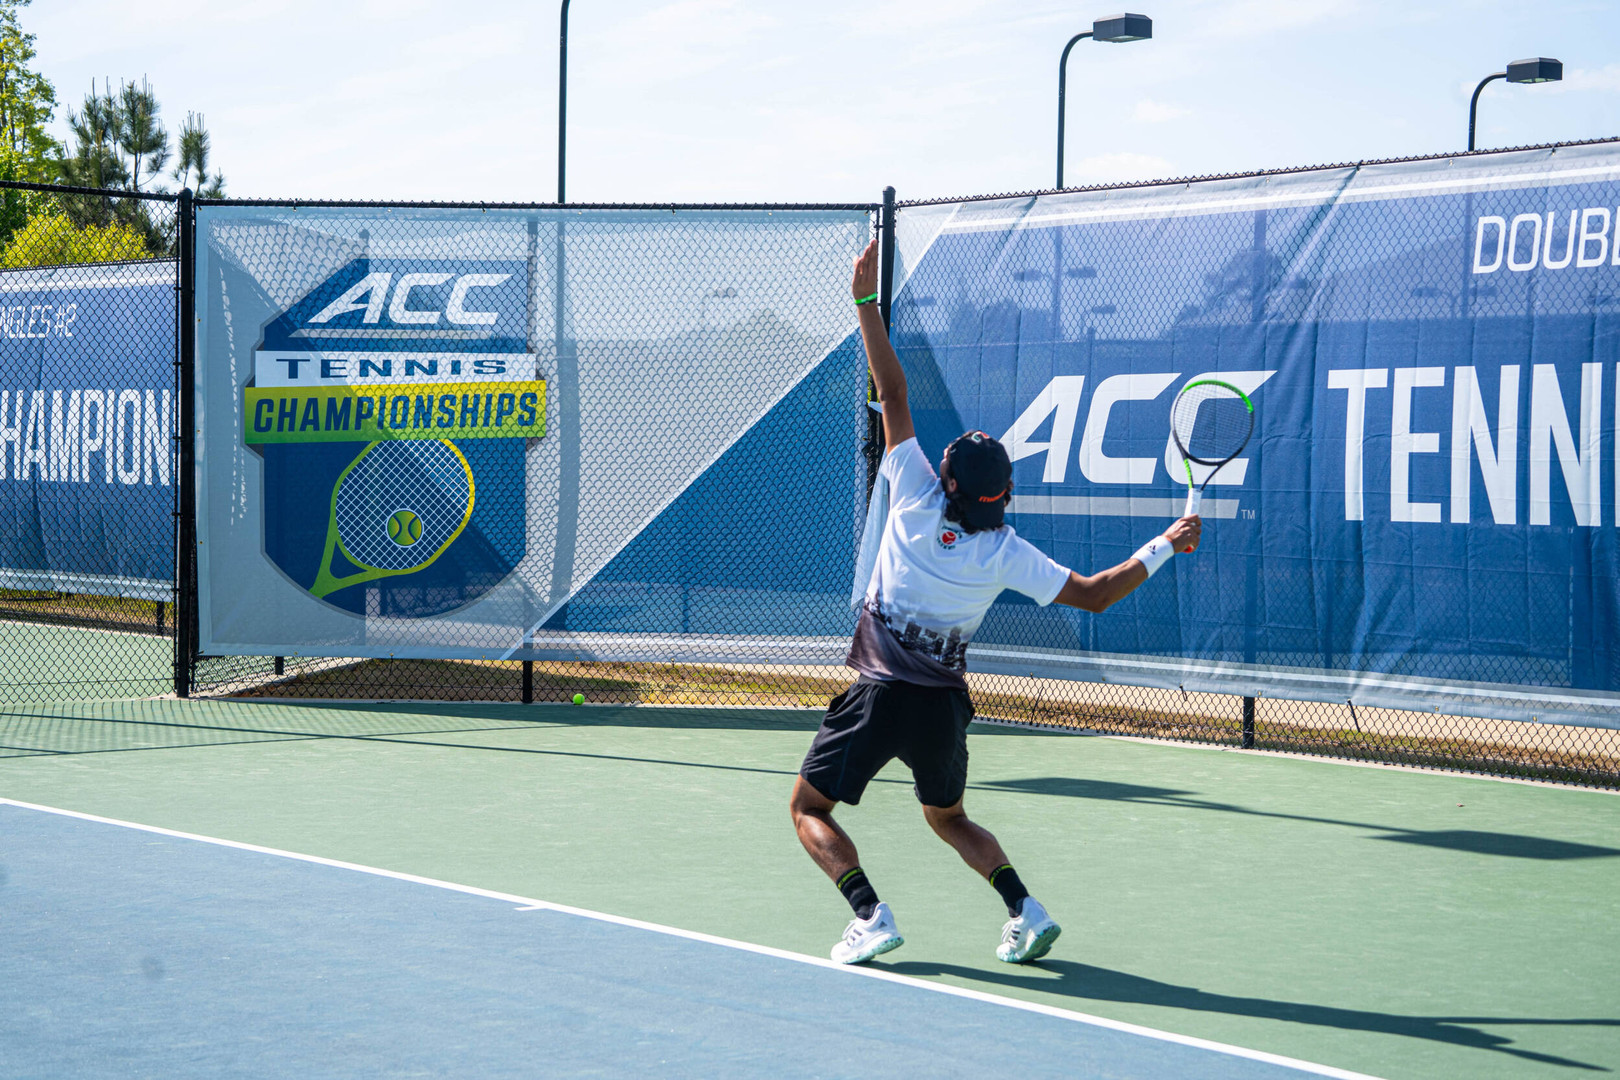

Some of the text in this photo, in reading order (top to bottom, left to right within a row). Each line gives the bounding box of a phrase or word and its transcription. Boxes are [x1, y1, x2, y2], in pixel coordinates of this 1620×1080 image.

[307, 272, 513, 325] ACC
[0, 303, 77, 338] NGLES #2
[275, 358, 507, 380] TENNIS
[253, 392, 538, 432] CHAMPIONSHIPS
[998, 361, 1620, 527] ACC TENN
[1240, 509, 1256, 521] TM
